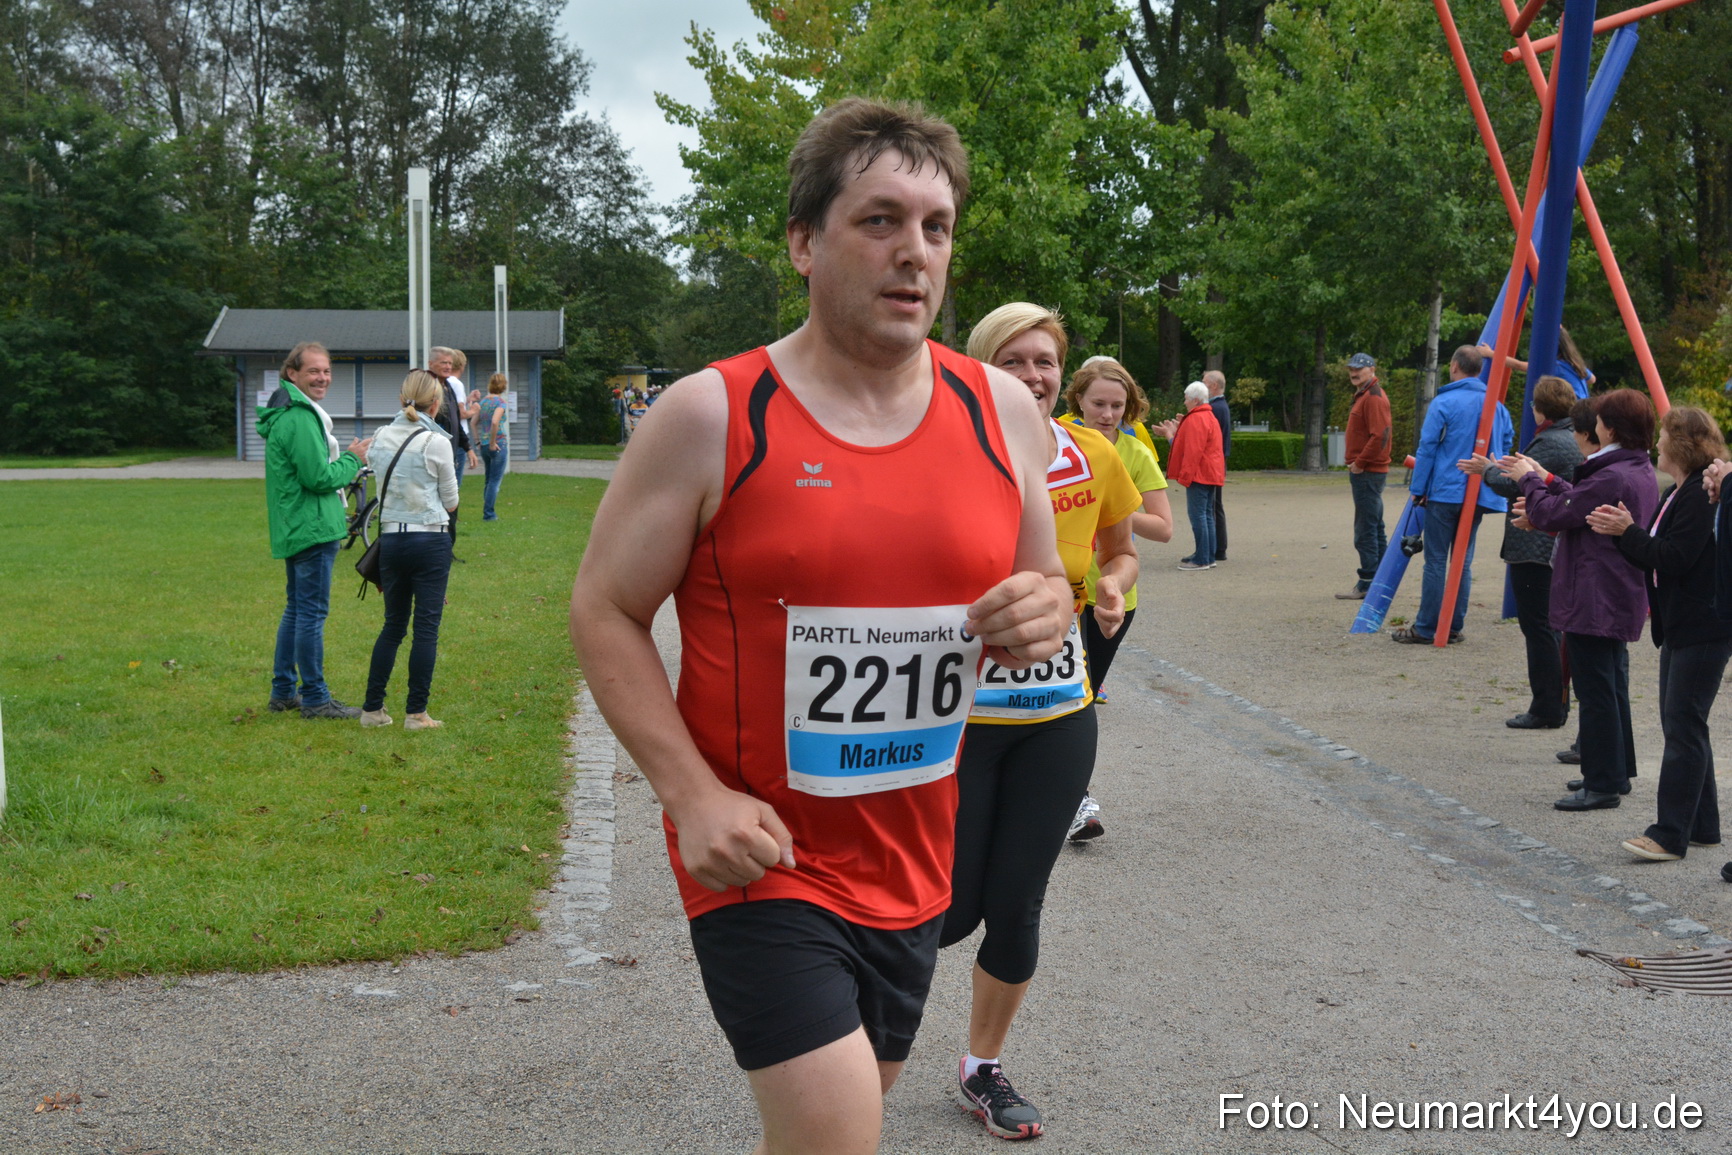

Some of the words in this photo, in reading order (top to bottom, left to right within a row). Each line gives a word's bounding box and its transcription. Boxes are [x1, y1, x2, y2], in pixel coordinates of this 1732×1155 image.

[796, 477, 832, 488] erima
[792, 626, 861, 644] PARTL
[867, 626, 954, 644] Neumarkt
[808, 652, 964, 723] 2216
[839, 741, 925, 769] Markus
